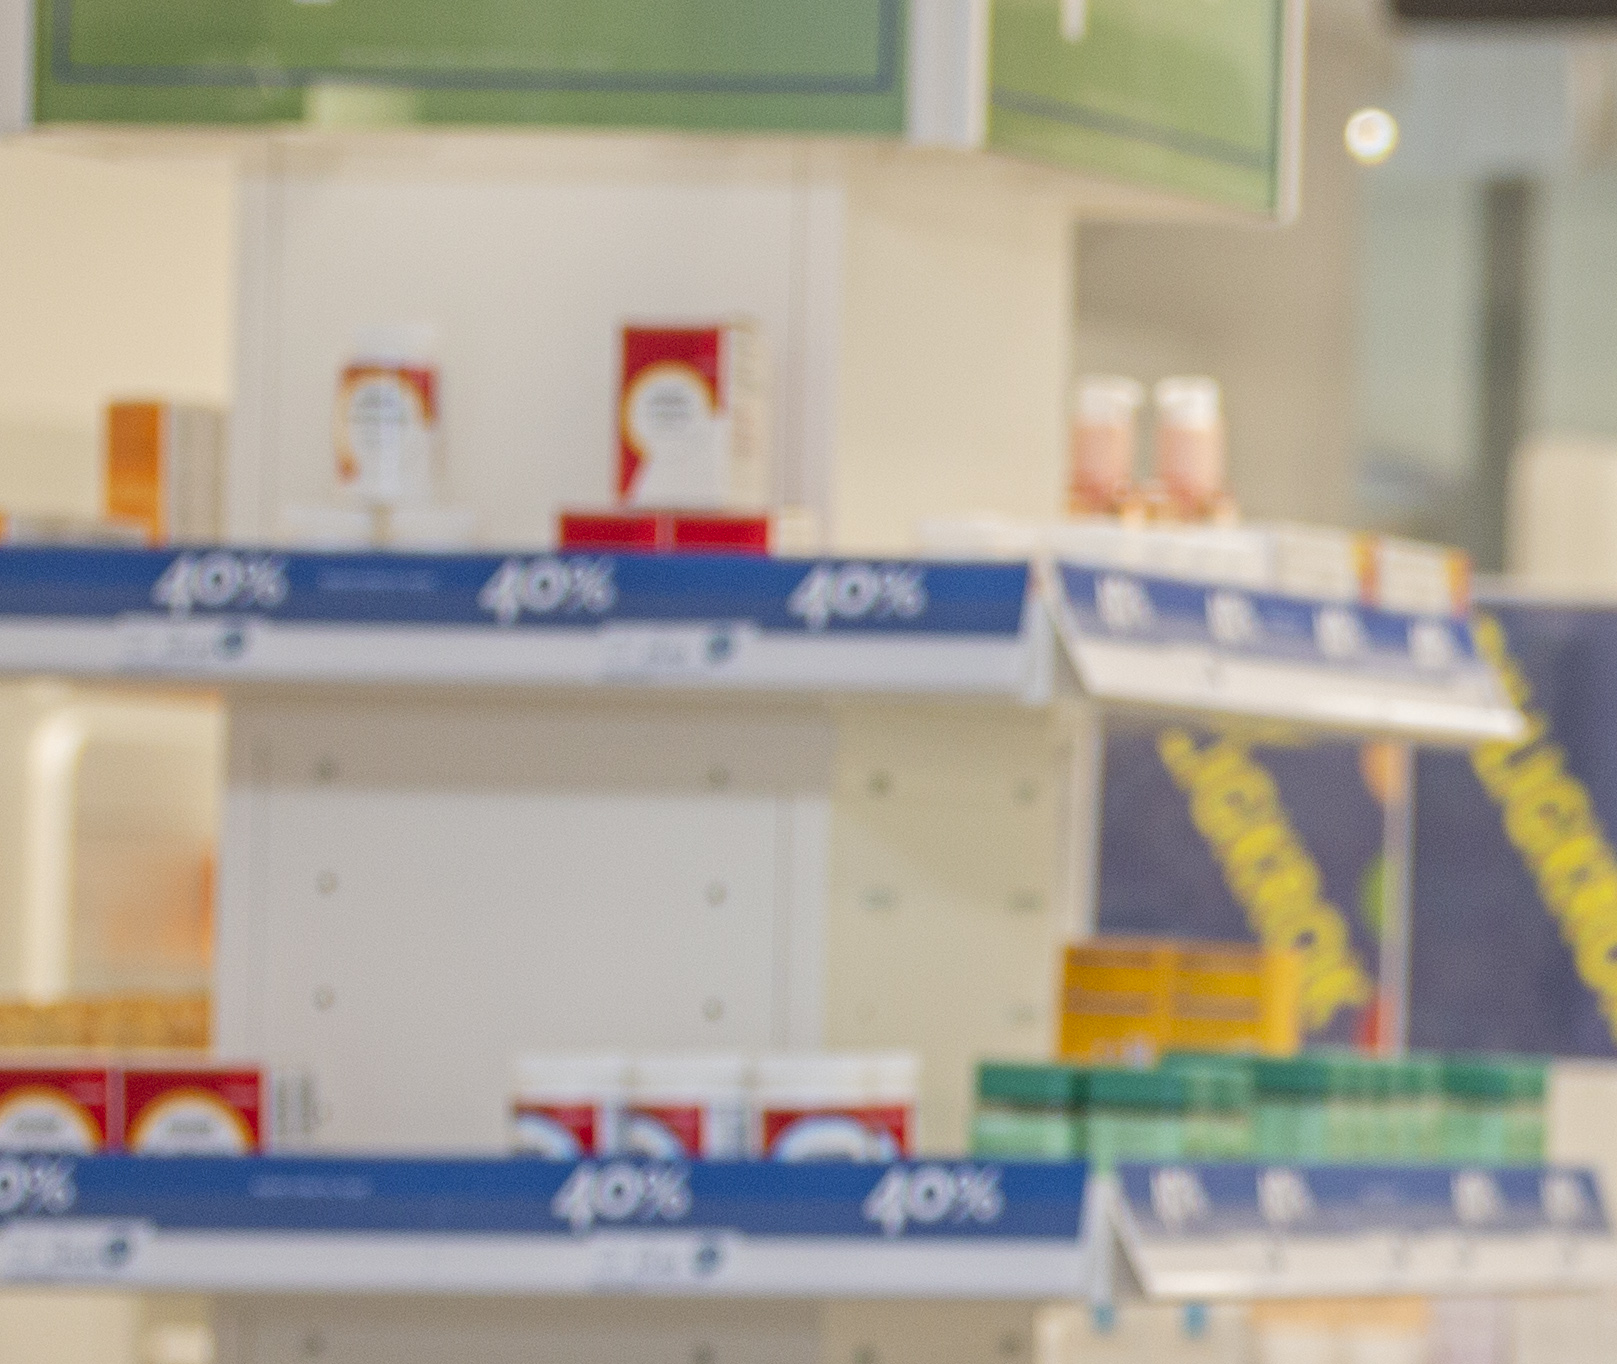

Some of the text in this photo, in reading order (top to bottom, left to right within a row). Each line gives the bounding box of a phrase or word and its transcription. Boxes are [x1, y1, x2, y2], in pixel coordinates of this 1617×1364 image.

[152, 554, 291, 619] 40%
[479, 556, 619, 625] 40%
[786, 563, 929, 632] 40%
[0, 1156, 77, 1213] 0%
[552, 1161, 693, 1236] 40%
[862, 1164, 1005, 1238] 40%
